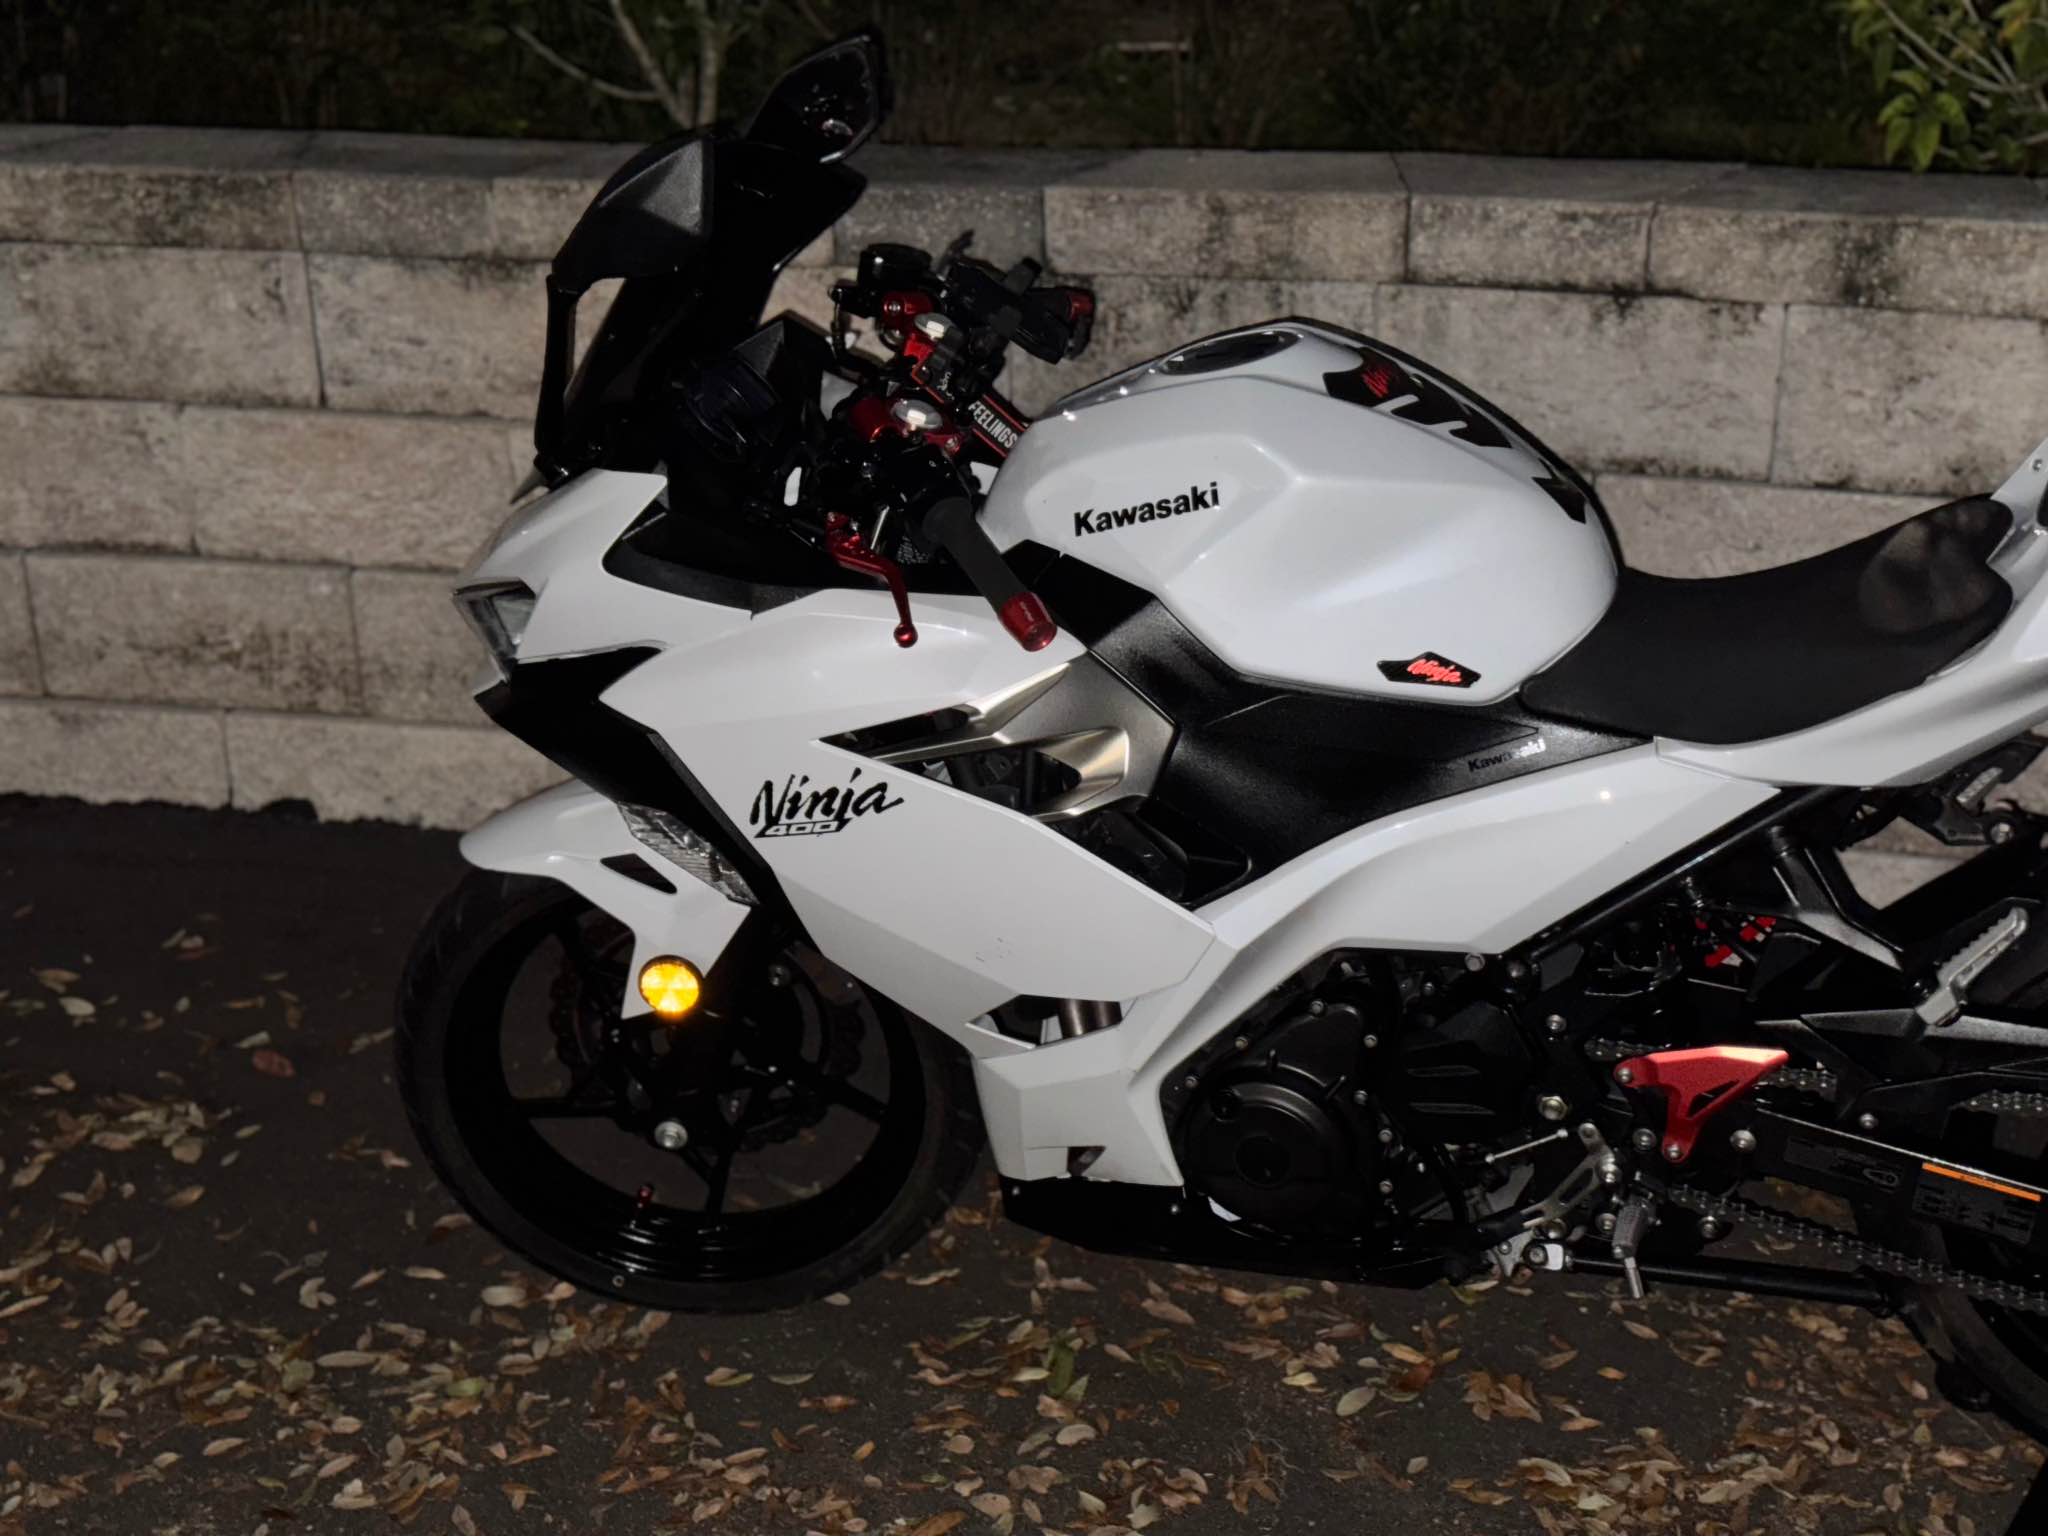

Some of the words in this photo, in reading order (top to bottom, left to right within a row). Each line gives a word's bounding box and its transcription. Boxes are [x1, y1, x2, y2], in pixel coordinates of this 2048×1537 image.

[968, 400, 1018, 449] FEELINGS
[1074, 481, 1219, 537] Kawasaki
[750, 767, 904, 826] Ninja
[764, 820, 840, 836] 400
